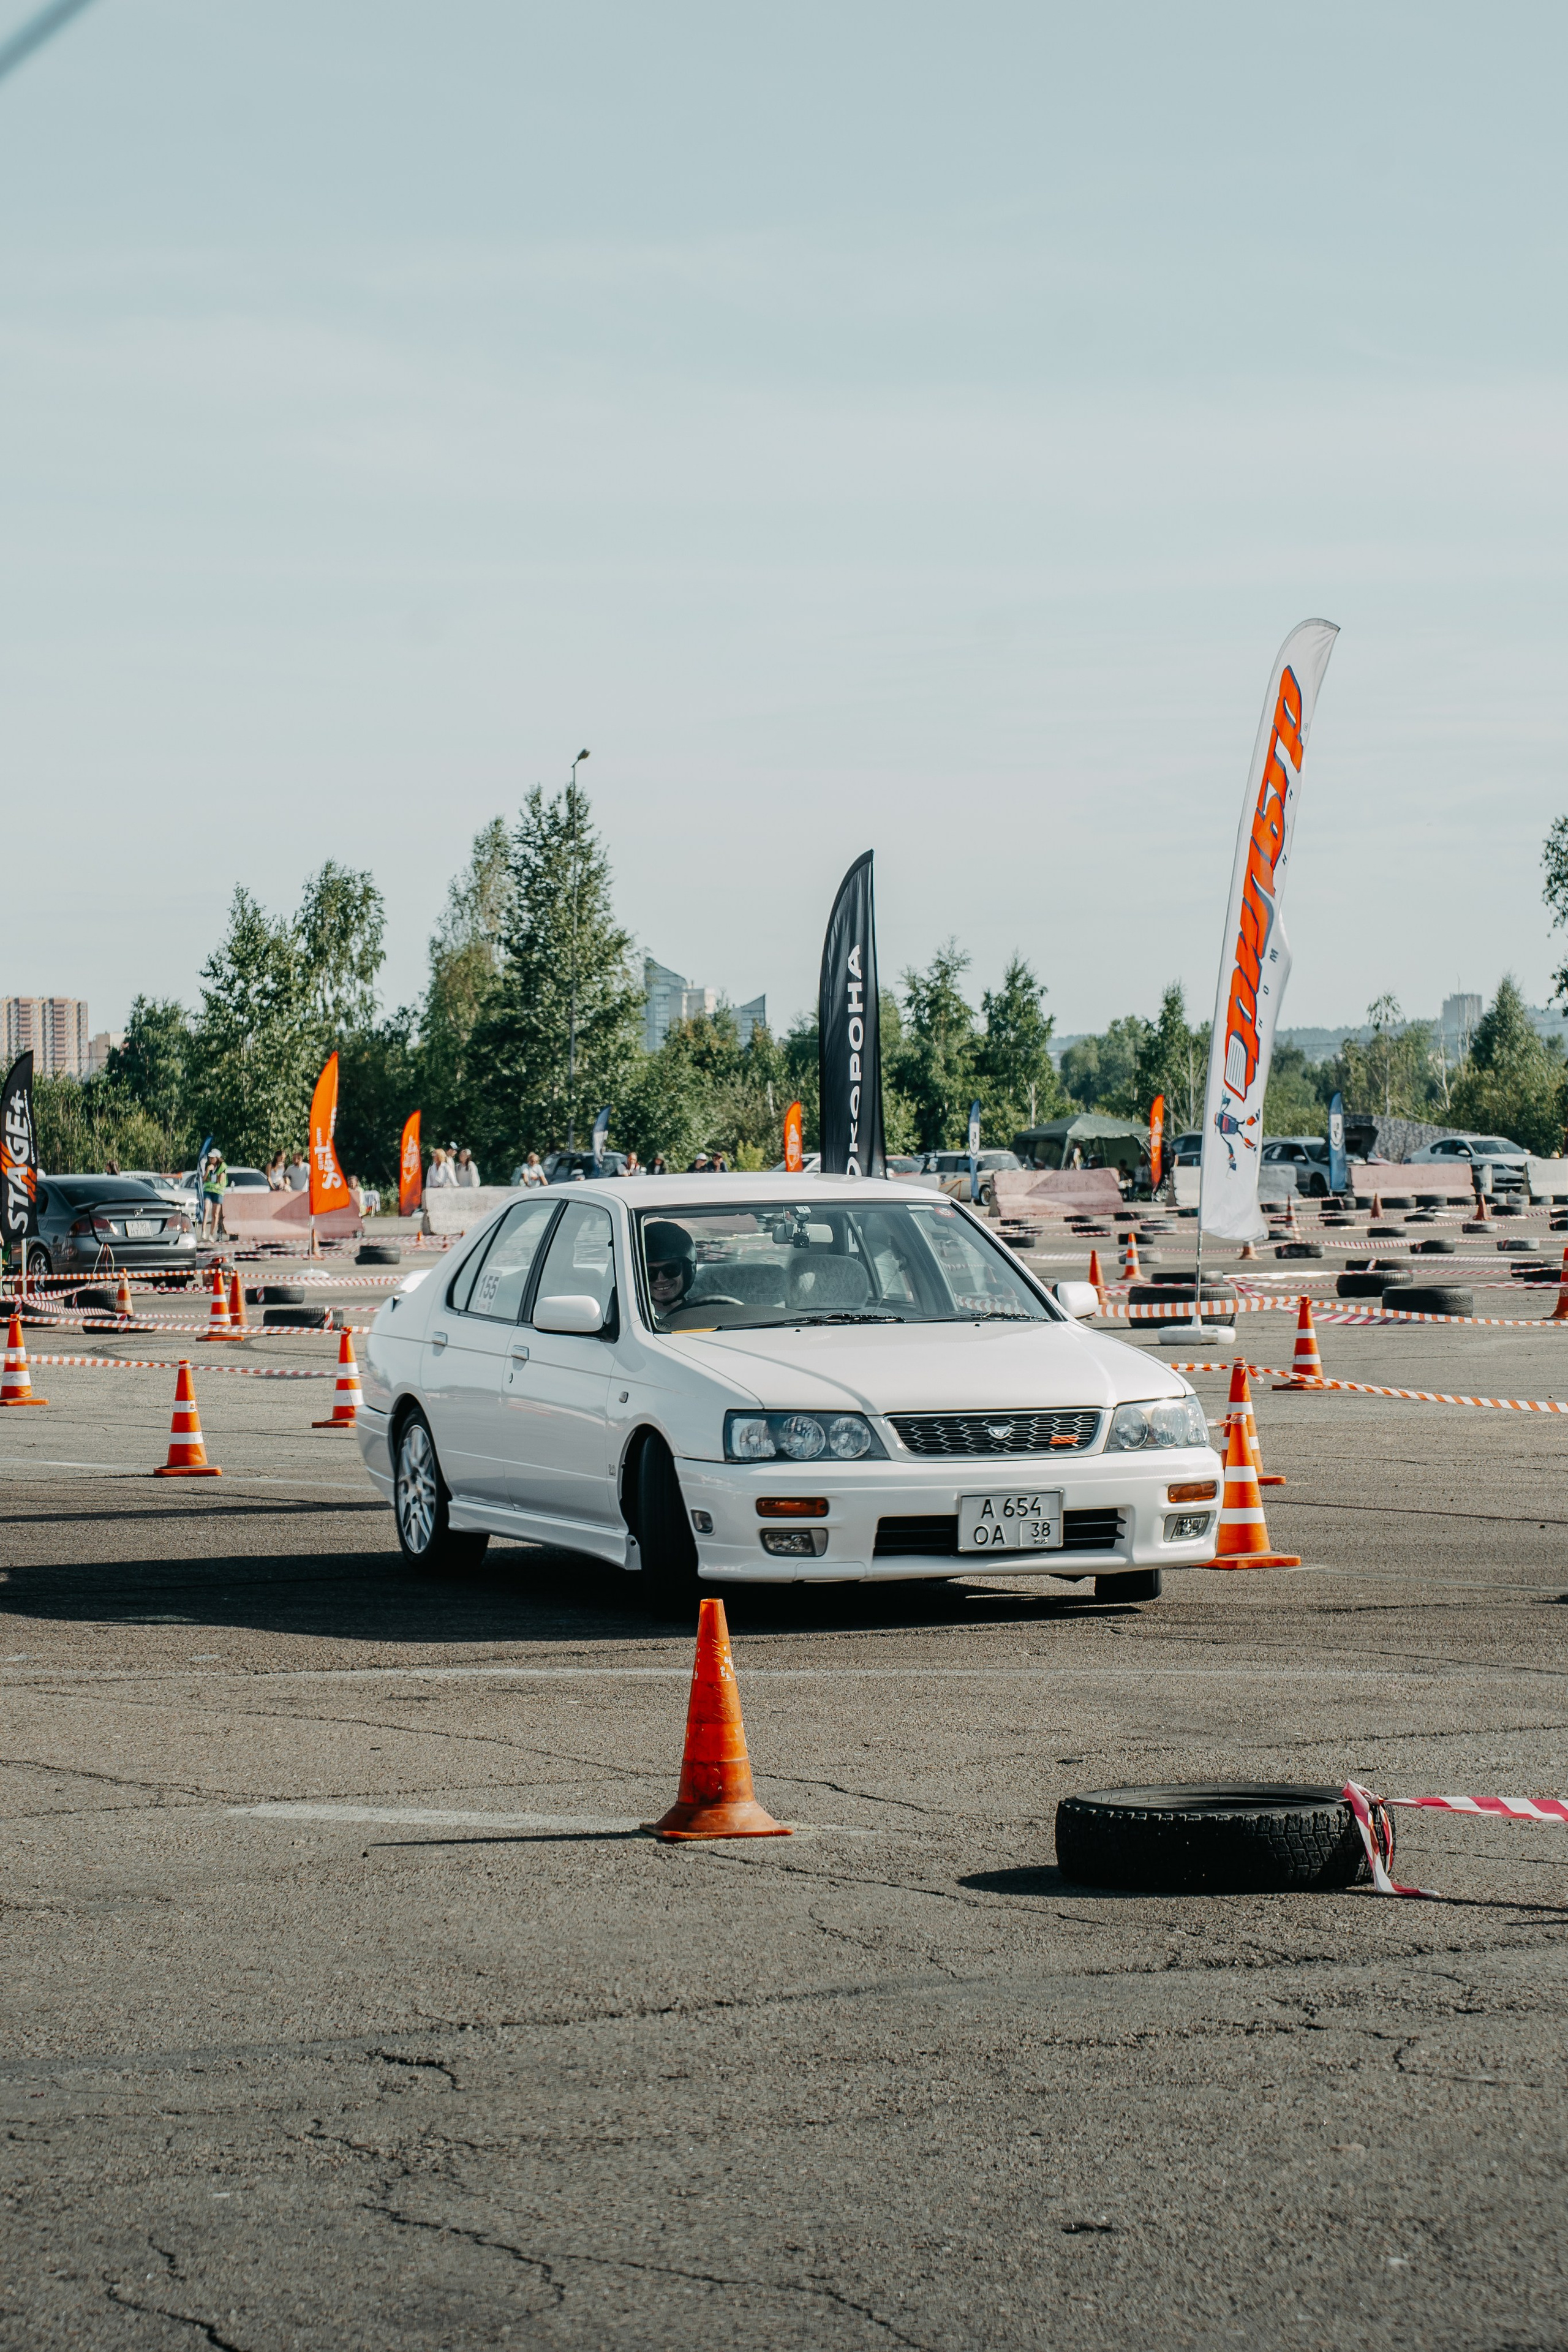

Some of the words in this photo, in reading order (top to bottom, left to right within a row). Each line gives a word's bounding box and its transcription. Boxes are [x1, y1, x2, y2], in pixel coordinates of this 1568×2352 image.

[478, 1275, 500, 1300] 155
[1003, 1495, 1043, 1518] 654
[1030, 1520, 1052, 1537] 38
